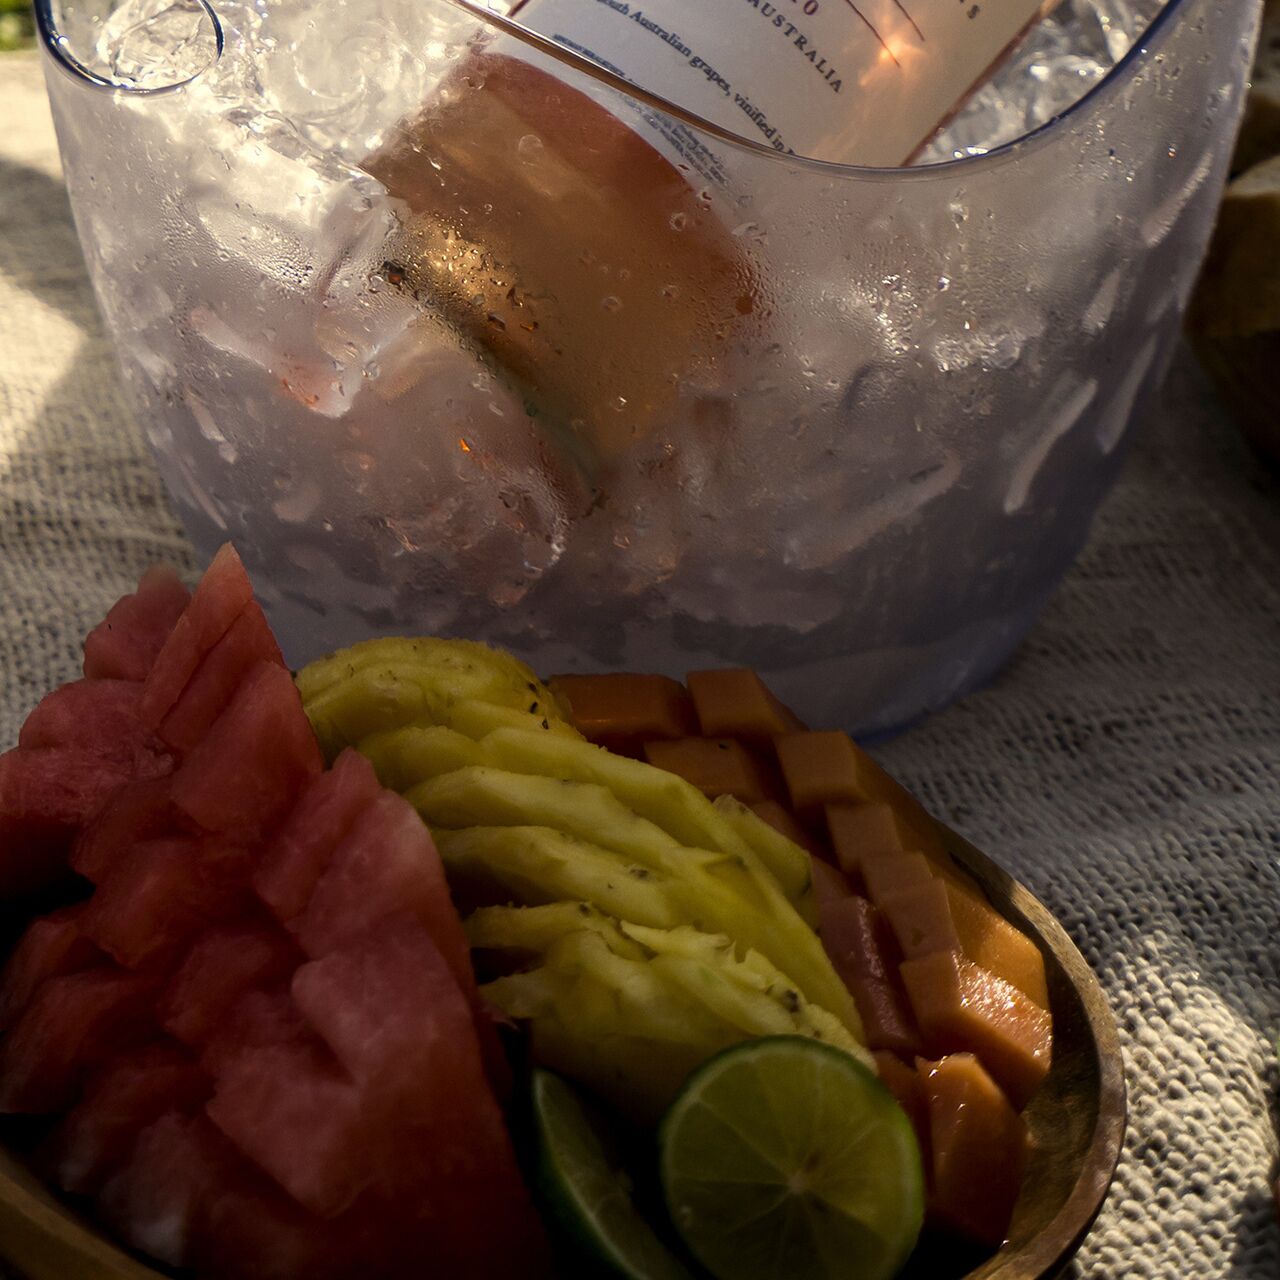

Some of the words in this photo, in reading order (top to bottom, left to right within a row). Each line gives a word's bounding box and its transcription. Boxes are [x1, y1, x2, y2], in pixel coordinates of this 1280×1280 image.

[629, 10, 693, 58] Australian
[689, 55, 732, 97] grapes,
[734, 93, 777, 140] vinified
